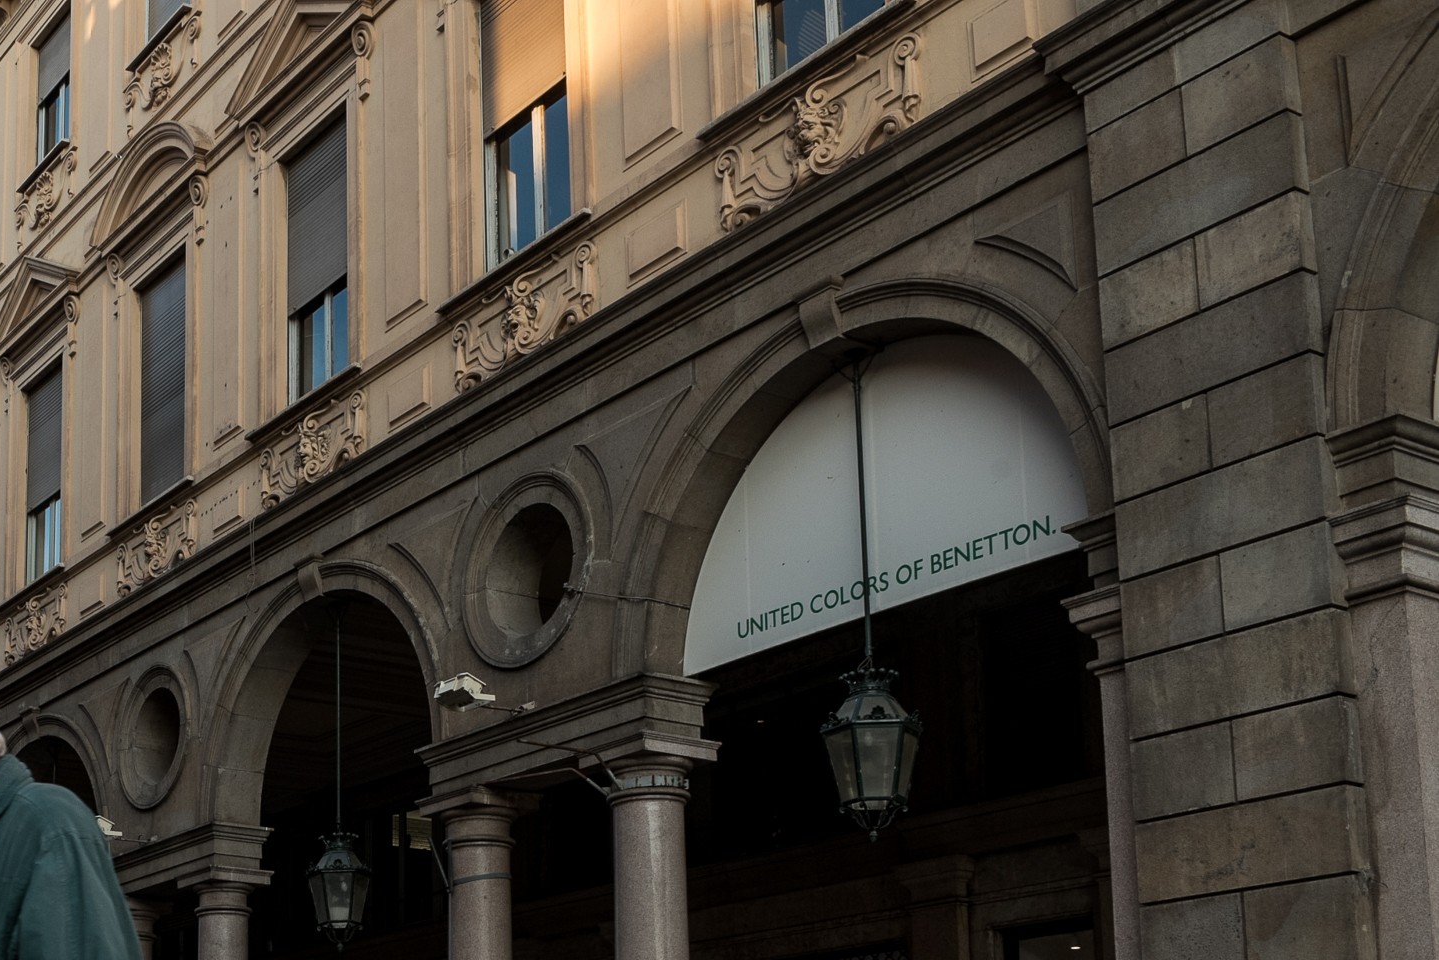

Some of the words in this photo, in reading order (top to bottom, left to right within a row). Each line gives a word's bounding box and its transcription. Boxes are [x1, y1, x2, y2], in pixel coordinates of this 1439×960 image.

[737, 602, 804, 639] UNITED
[810, 571, 889, 613] COLORS
[896, 558, 923, 585] OF
[930, 515, 1056, 575] BENETTON.
